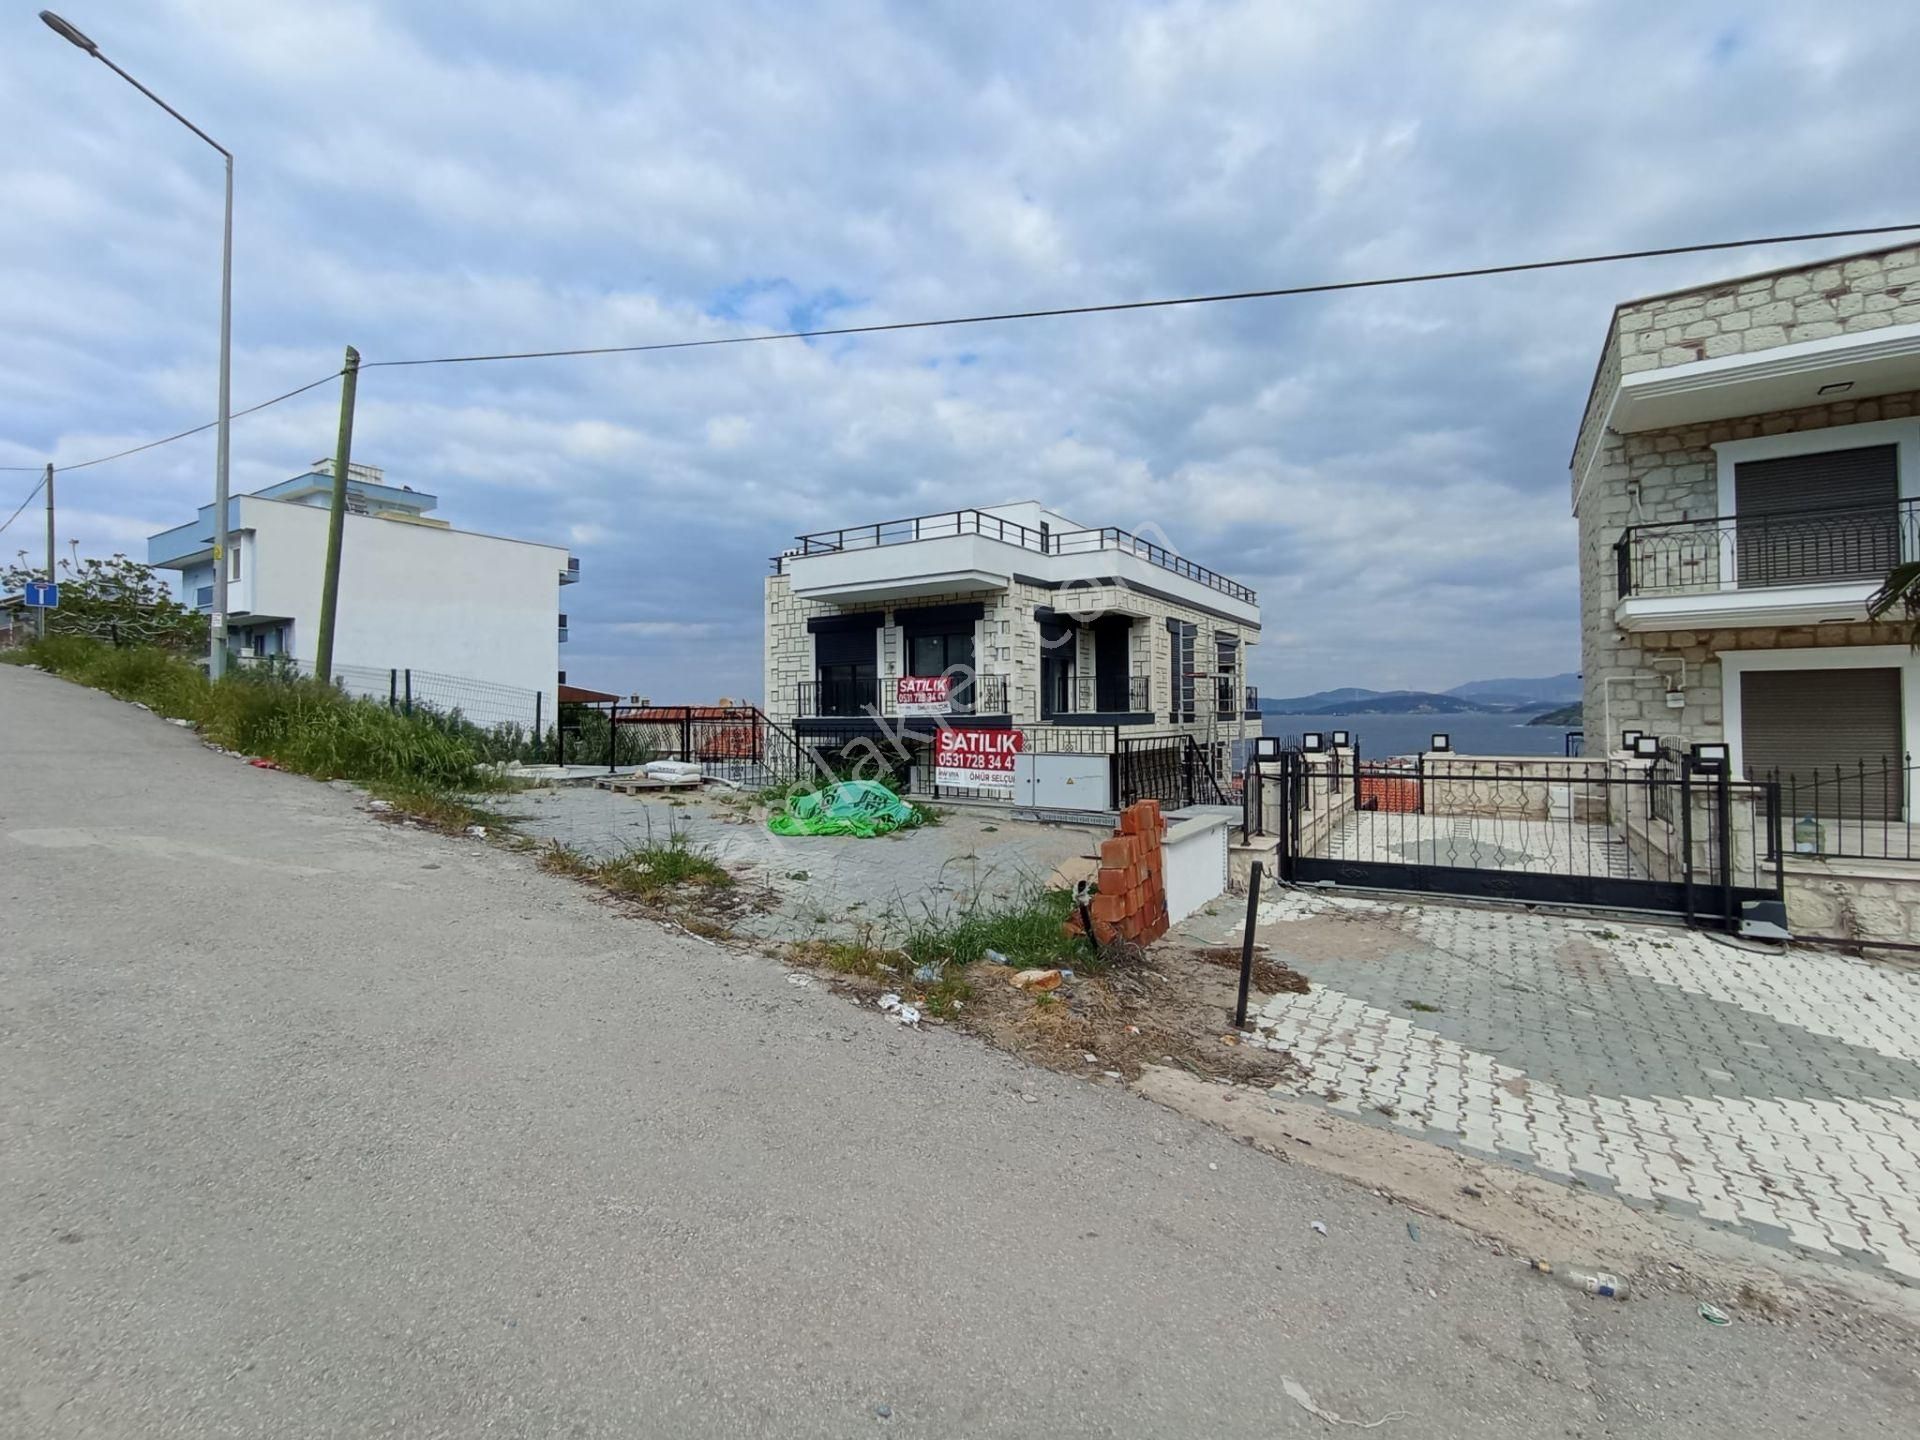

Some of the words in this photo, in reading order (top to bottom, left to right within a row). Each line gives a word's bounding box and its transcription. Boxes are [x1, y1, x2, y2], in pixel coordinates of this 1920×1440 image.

[900, 679, 947, 692] SATILIK
[941, 732, 1017, 753] SATILIK
[939, 752, 964, 767] 0531
[966, 753, 985, 769] 728
[988, 754, 1001, 769] 34
